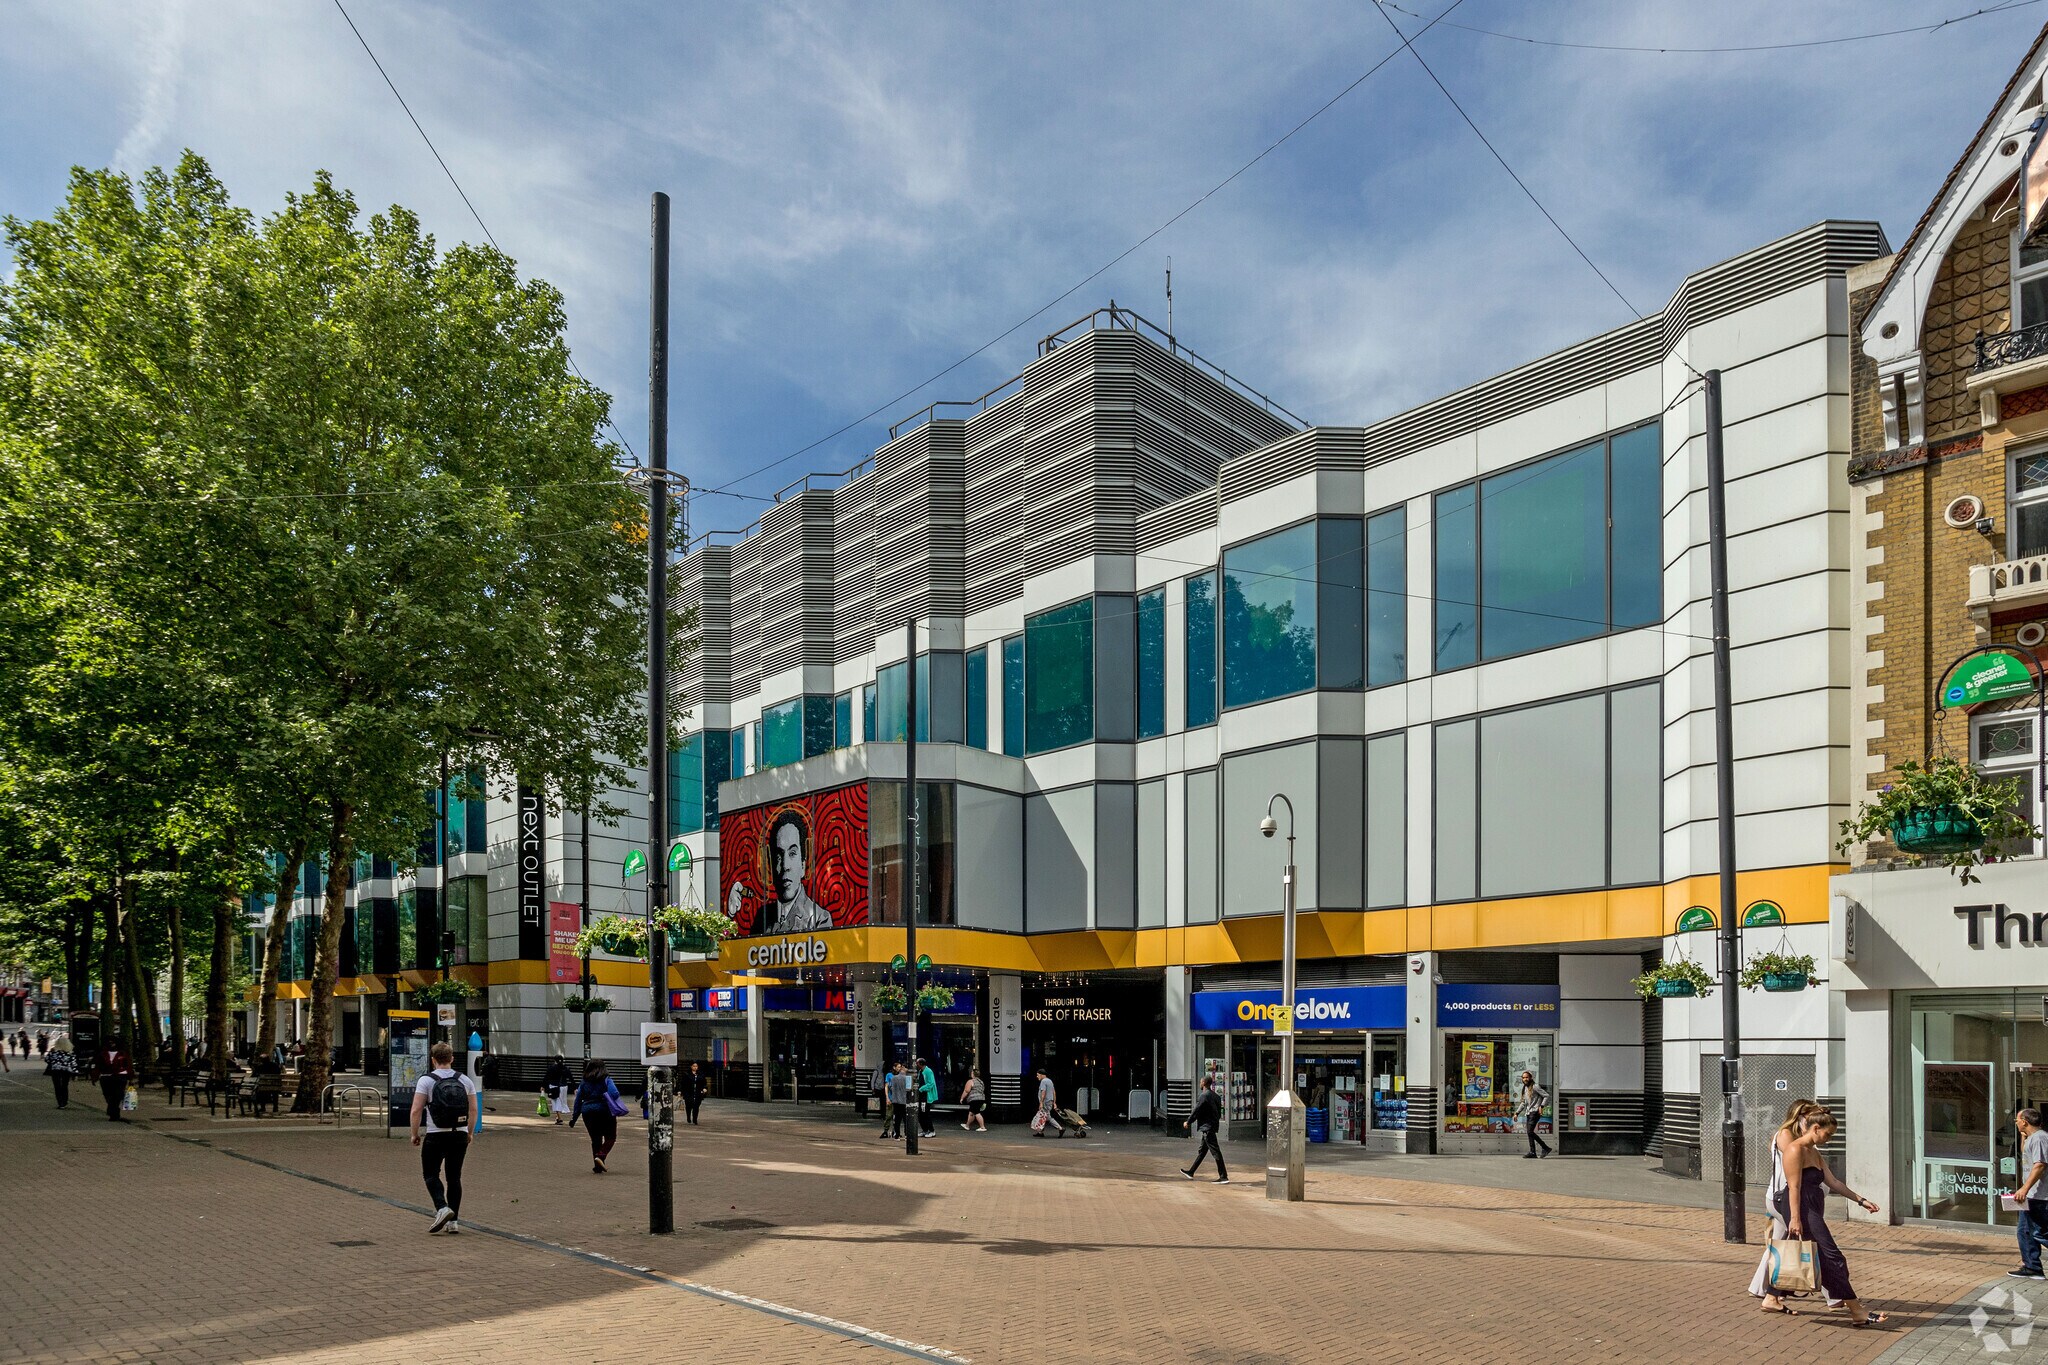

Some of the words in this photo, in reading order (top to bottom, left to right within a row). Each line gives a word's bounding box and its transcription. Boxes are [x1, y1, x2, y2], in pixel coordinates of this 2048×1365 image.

[1972, 663, 2006, 681] cleaner
[1974, 669, 2008, 688] greener
[522, 796, 539, 851] next
[524, 855, 539, 928] OUTLET
[748, 936, 827, 966] centrale
[1044, 998, 1075, 1006] THROUGH
[1076, 998, 1085, 1006] TO
[1444, 1002, 1470, 1011] 4,000
[1471, 1002, 1511, 1011] products
[1056, 1010, 1070, 1020] OF
[1073, 1008, 1112, 1020] FRASER
[1495, 1120, 1503, 1129] 2
[1936, 1172, 1988, 1184] BigValue
